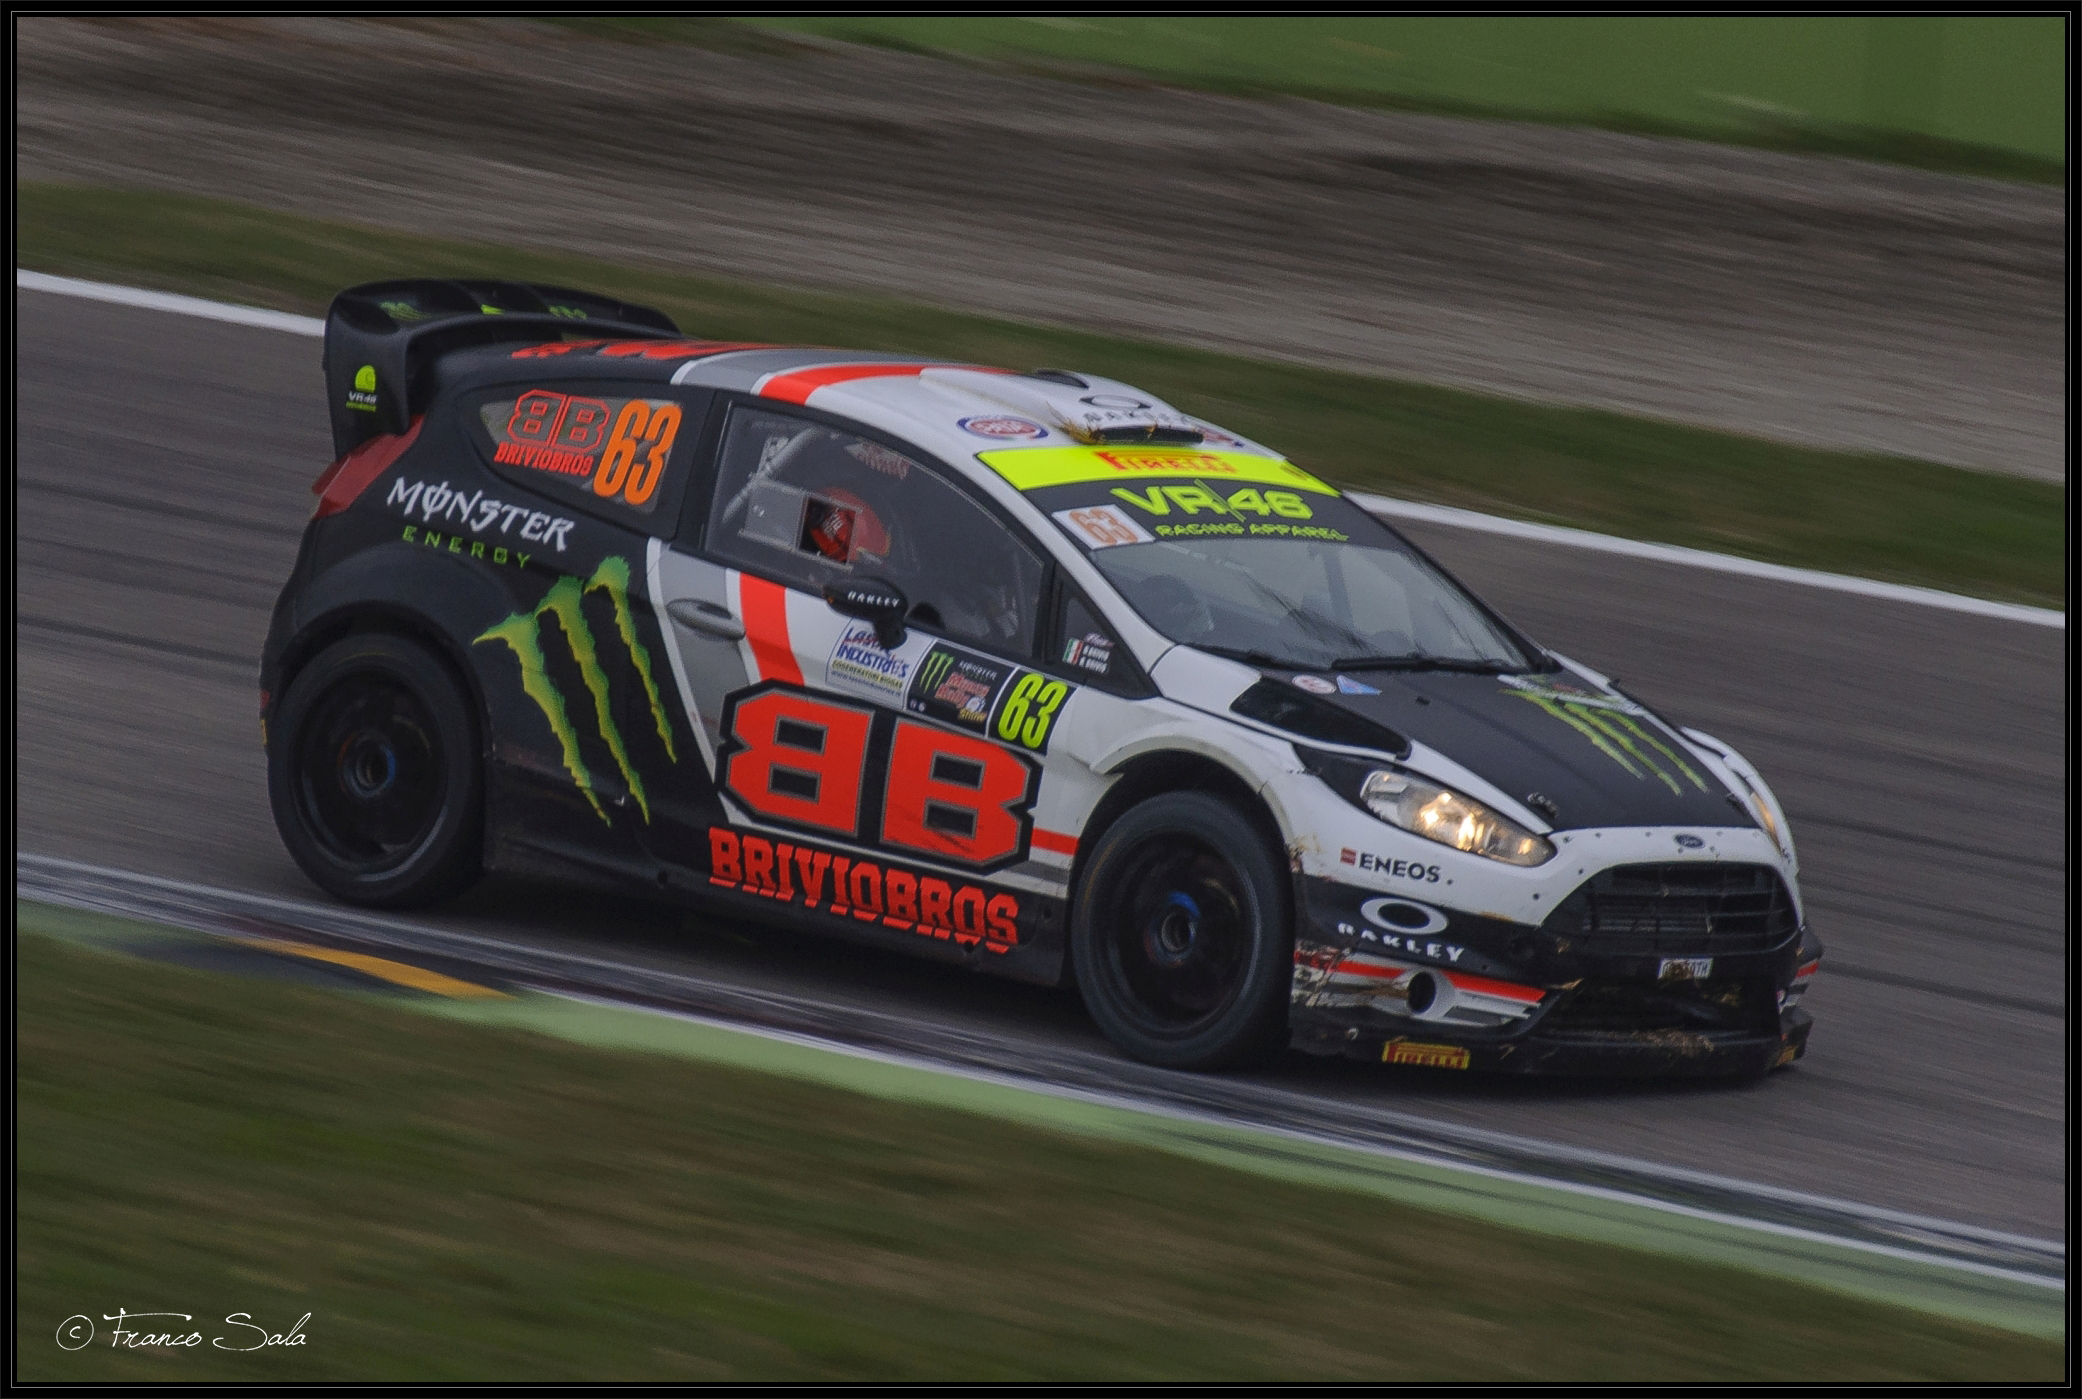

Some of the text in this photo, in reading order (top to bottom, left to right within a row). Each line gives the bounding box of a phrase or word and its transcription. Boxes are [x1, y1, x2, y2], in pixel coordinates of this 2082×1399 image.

[494, 441, 595, 477] BRIVIOBROS
[593, 398, 683, 505] 63
[402, 525, 531, 569] ENERGY
[1068, 508, 1139, 546] 63
[1155, 523, 1350, 542] RACING APPAREL
[997, 672, 1069, 750] 63
[1359, 852, 1442, 883] ENEOS
[708, 825, 1020, 954] BRIVIOBROS
[1337, 922, 1465, 962] OAKLEY
